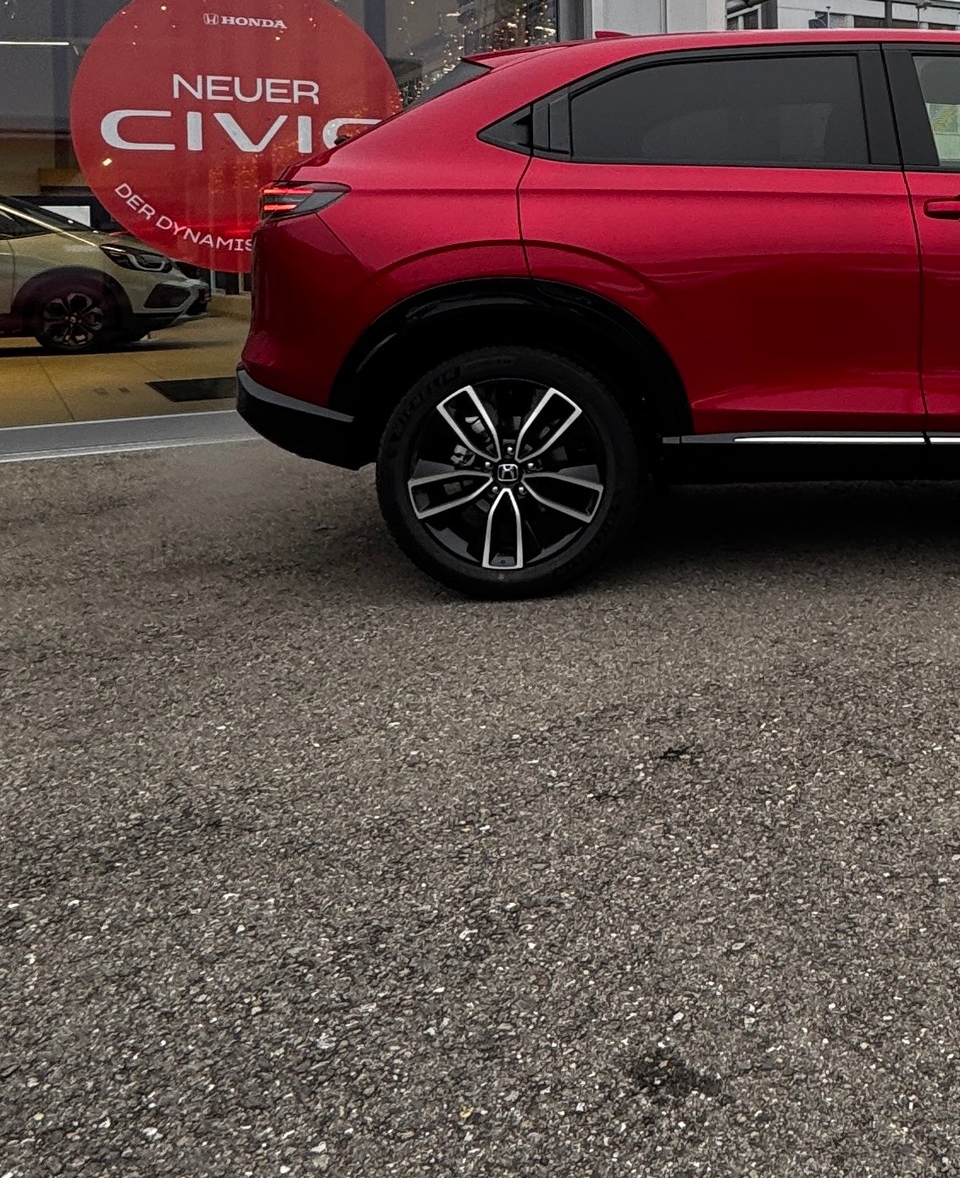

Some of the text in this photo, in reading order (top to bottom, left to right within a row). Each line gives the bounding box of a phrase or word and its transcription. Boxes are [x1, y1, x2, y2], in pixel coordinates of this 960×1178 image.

[221, 15, 288, 29] HONDA
[172, 73, 320, 105] NEUER
[114, 182, 156, 221] DER
